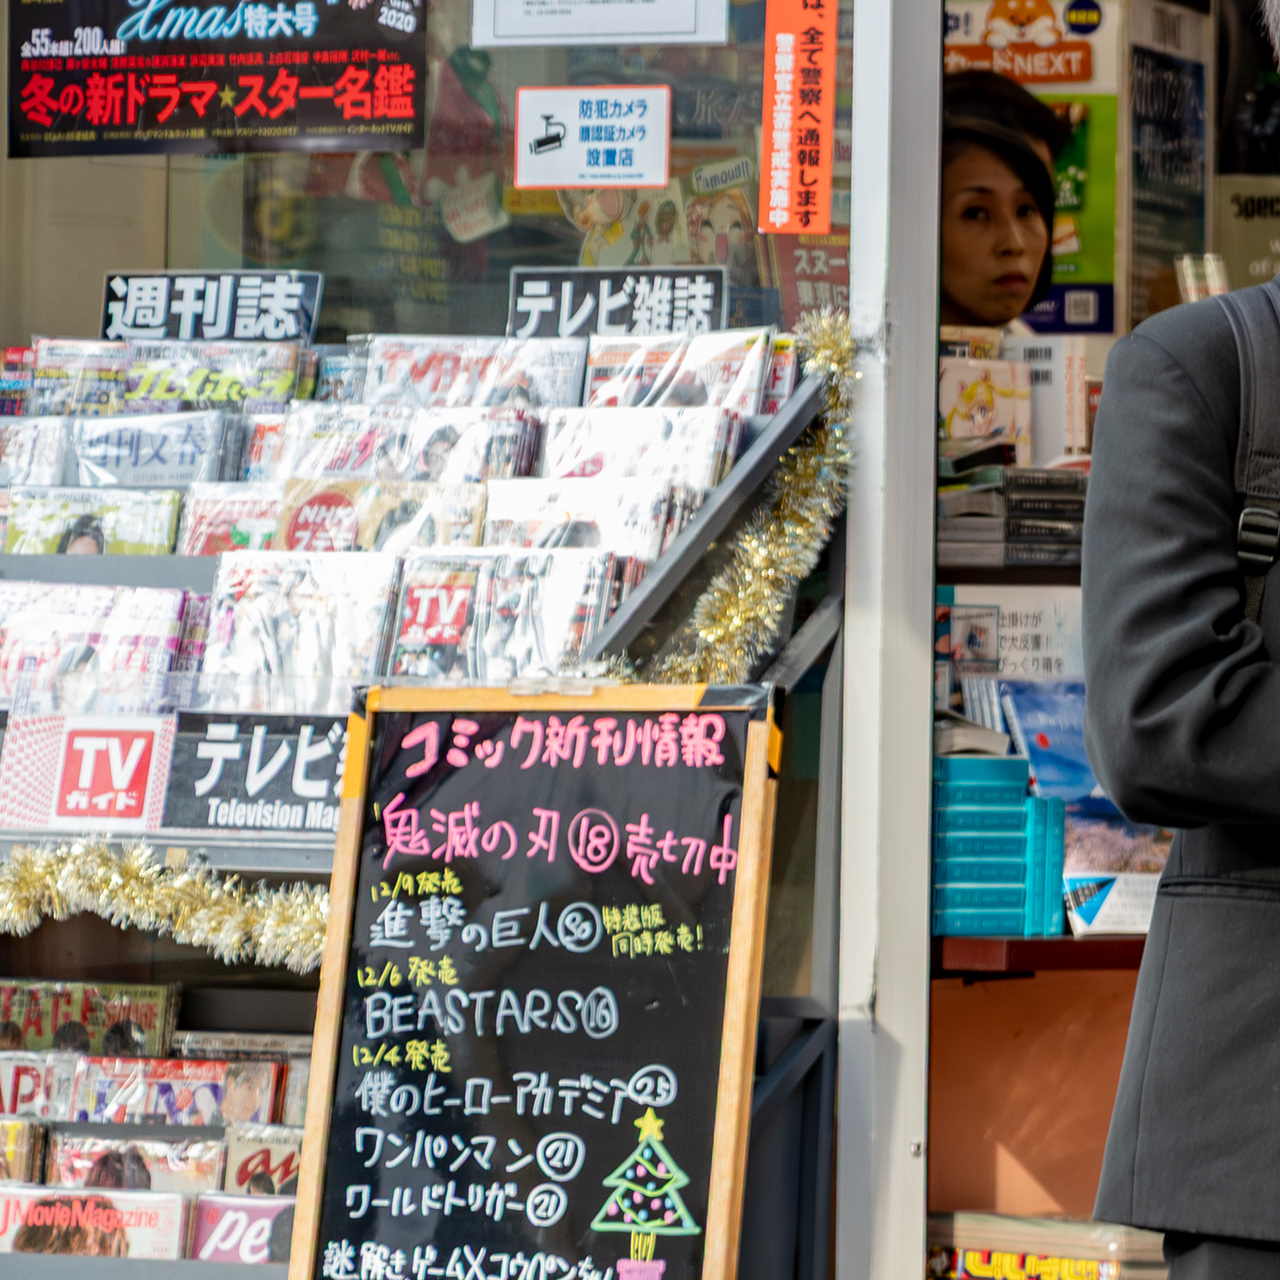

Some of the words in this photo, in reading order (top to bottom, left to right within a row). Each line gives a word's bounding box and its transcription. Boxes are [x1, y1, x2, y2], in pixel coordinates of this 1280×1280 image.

[378, 8, 417, 33] 2020
[579, 99, 647, 119] 防犯カメラ
[579, 125, 646, 142] 顔認証カメラ
[586, 148, 634, 168] 設置店
[106, 275, 305, 340] 週刊誌
[516, 275, 715, 338] テレビ雑誌
[411, 588, 468, 622] TV
[402, 712, 726, 778] コミック新刊情報
[72, 736, 147, 790] TV
[65, 790, 138, 811] ガイド
[208, 798, 305, 827] Television
